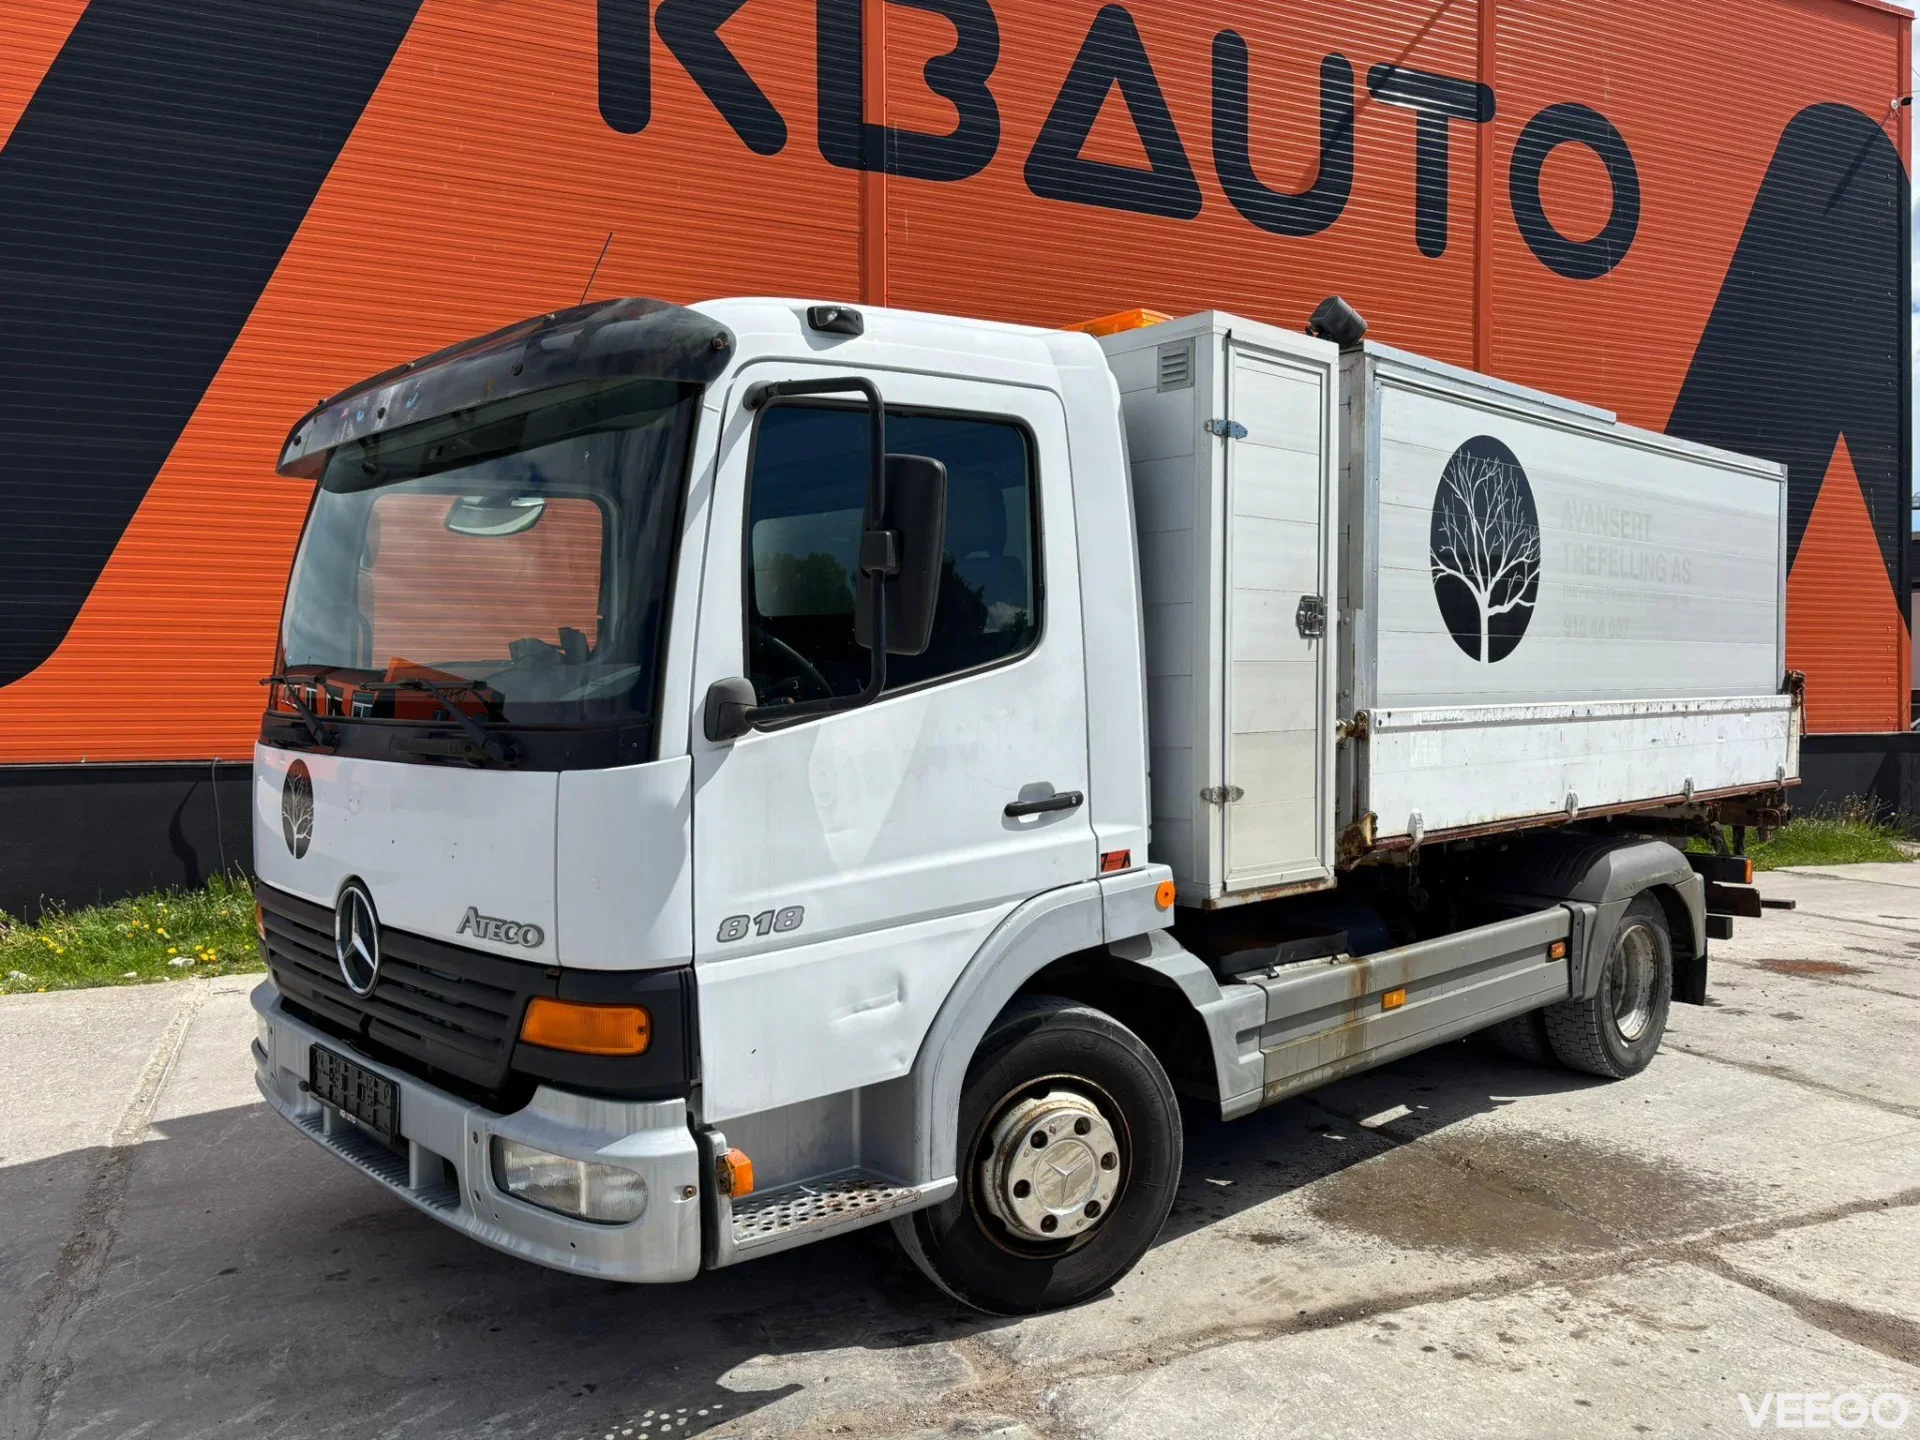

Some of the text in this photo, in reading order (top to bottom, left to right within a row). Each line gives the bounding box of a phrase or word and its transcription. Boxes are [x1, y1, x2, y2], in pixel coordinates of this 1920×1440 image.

[1560, 499, 1654, 541] AVANSERT
[1561, 540, 1692, 585] TREFELLING AS
[717, 905, 805, 943] 818
